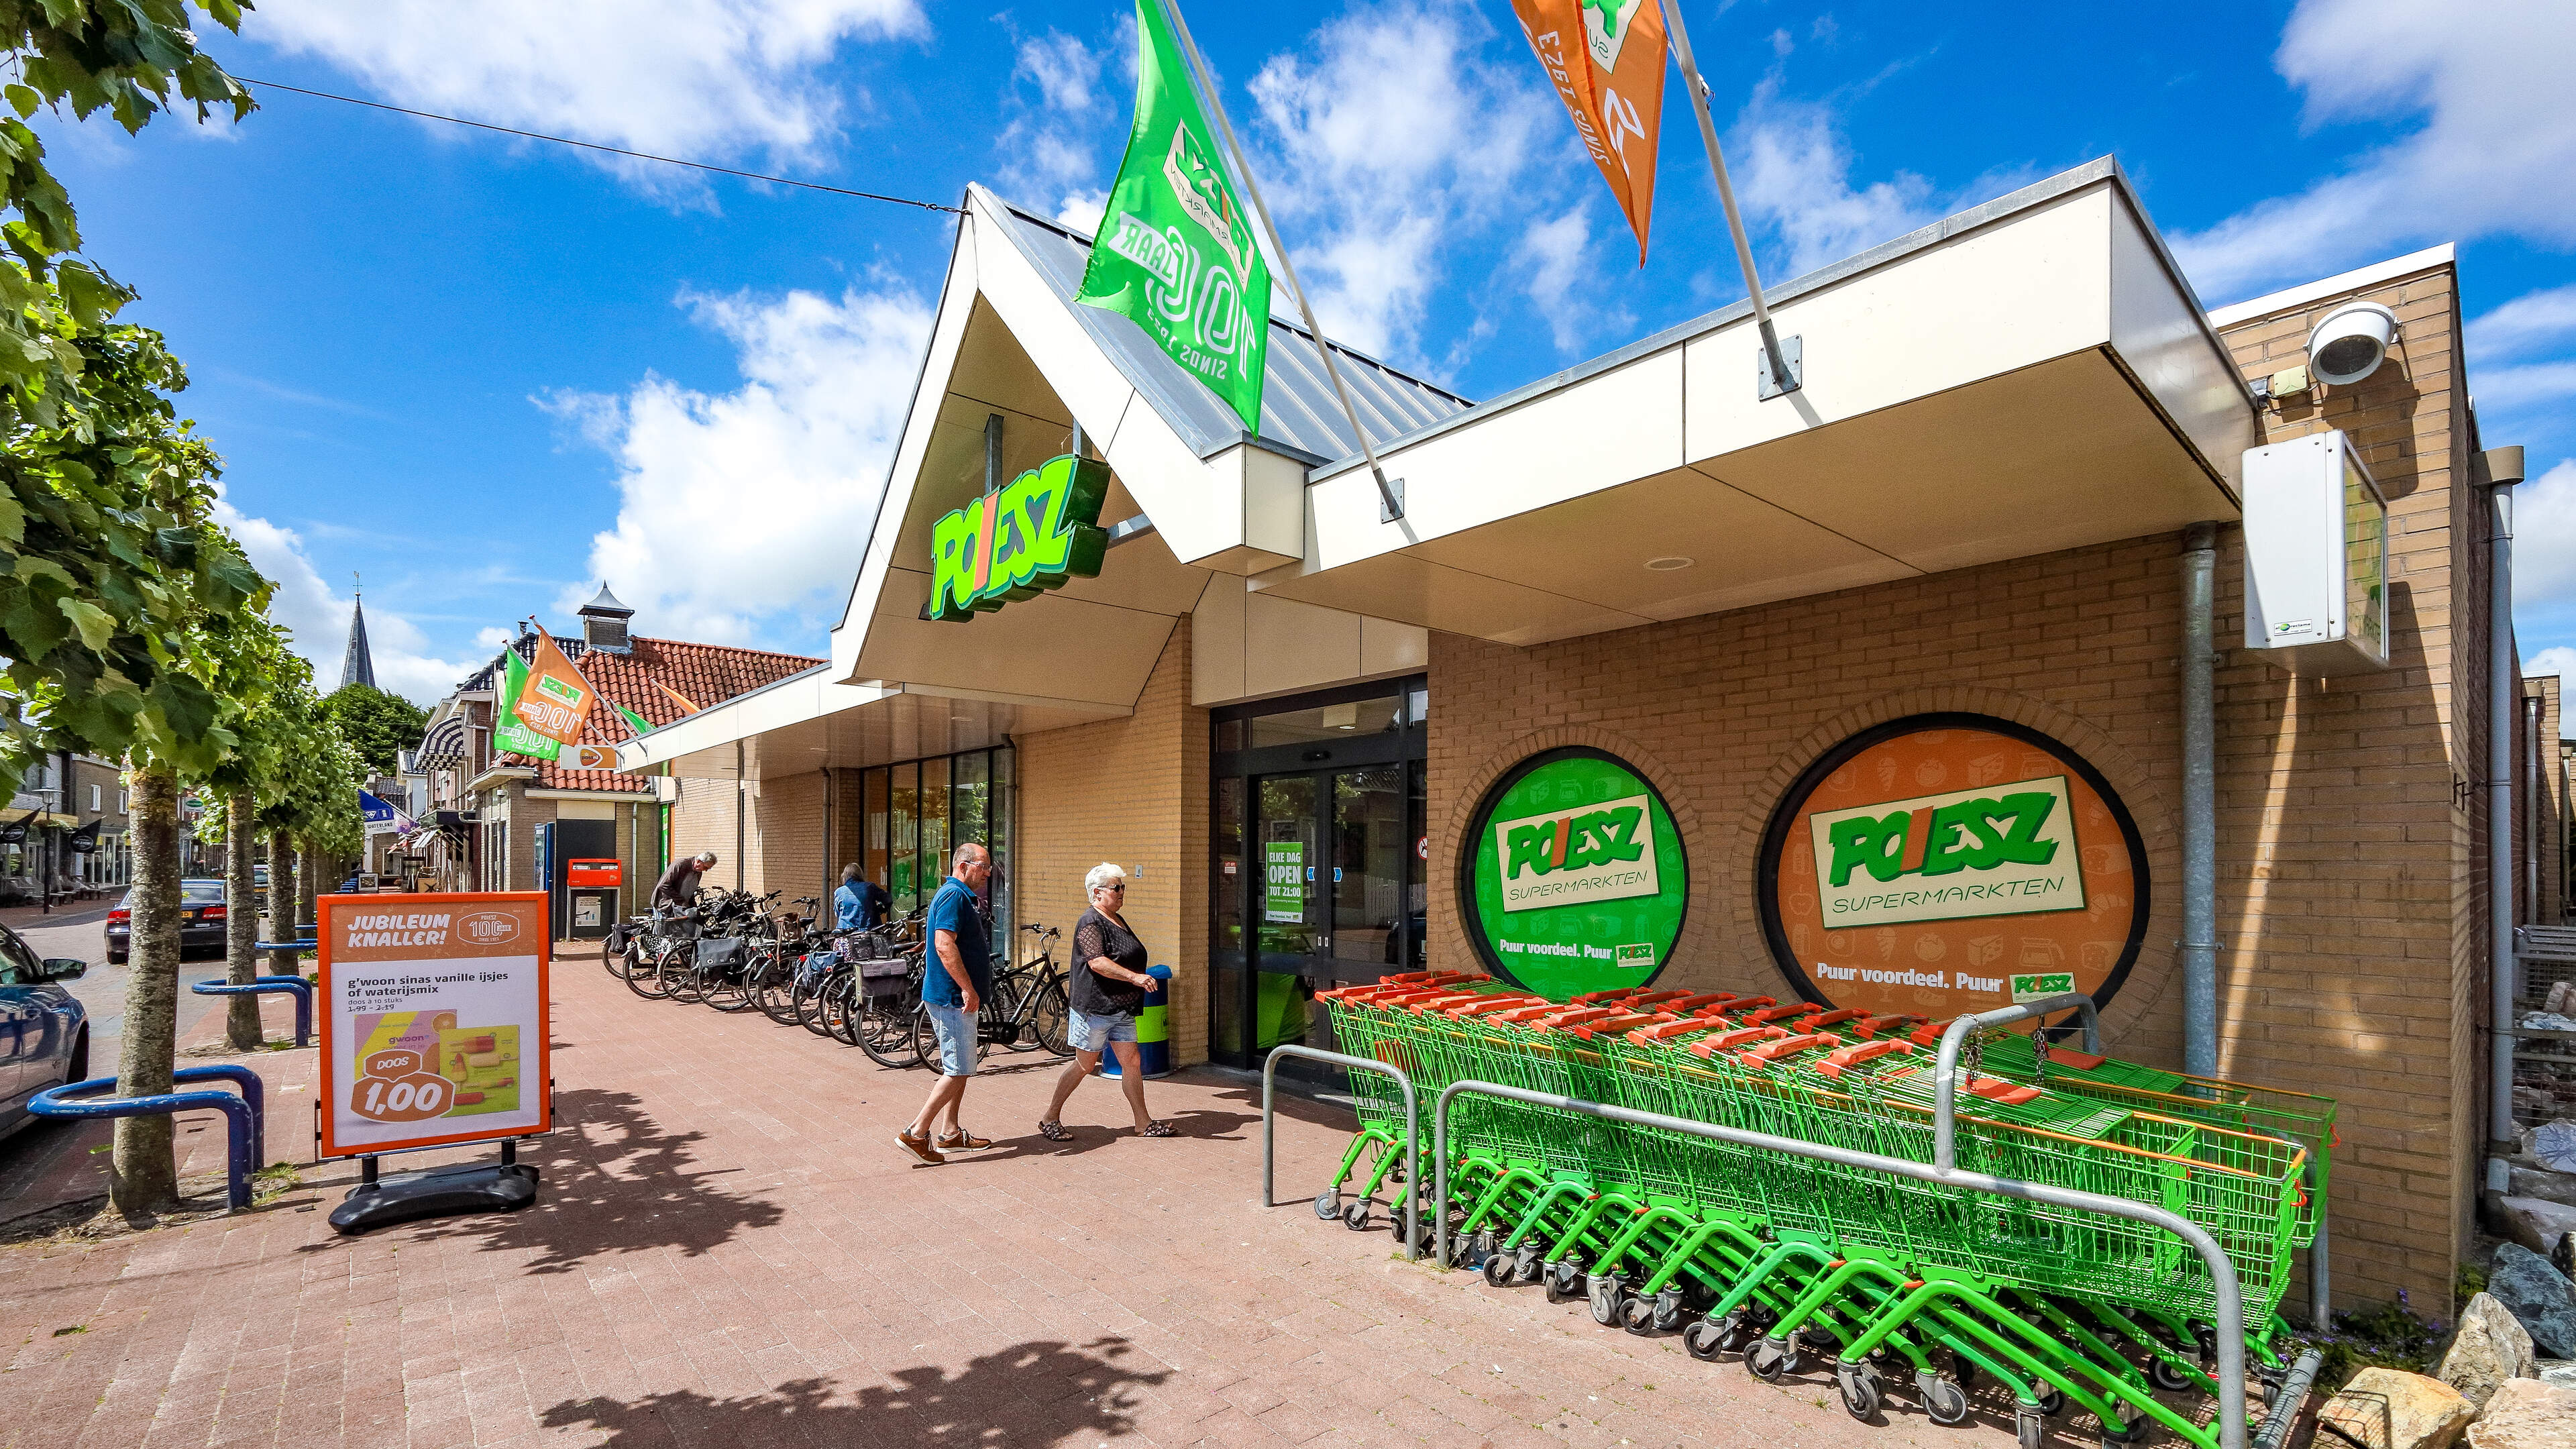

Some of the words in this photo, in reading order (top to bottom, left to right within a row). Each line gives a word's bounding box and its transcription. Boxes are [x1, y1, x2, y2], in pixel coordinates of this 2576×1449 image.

[1538, 30, 1576, 99] 1923
[930, 453, 1079, 621] POIESZ
[1507, 806, 1645, 880] POIESZ
[1828, 792, 2059, 888] POIESZ
[1269, 852, 1285, 863] ELKE
[1287, 852, 1301, 863] DAG
[1269, 865, 1301, 884] OPEN
[1509, 870, 1648, 901] SUPERMARKTEN
[1269, 886, 1281, 896] TOT
[1282, 887, 1301, 898] 21:00
[1832, 876, 2065, 914] SUPERMARKTEN
[347, 914, 451, 931] JUBILEUM
[1500, 939, 1525, 953] Puur
[1527, 943, 1580, 957] voordeel.
[1584, 945, 1613, 959] Puur
[1618, 945, 1652, 959] POIESZ
[399, 975, 431, 985] sinas
[435, 973, 476, 983] vanille
[479, 971, 508, 982] ijsjes
[1817, 961, 1858, 981] Puur
[1861, 967, 1950, 989] voordeel.
[1956, 970, 2004, 994] Puur
[2014, 975, 2072, 994] POIESZ
[348, 989, 361, 998] of
[365, 985, 439, 997] waterijsmix
[376, 1056, 410, 1071] DOOS
[365, 1082, 443, 1116] 1,00
